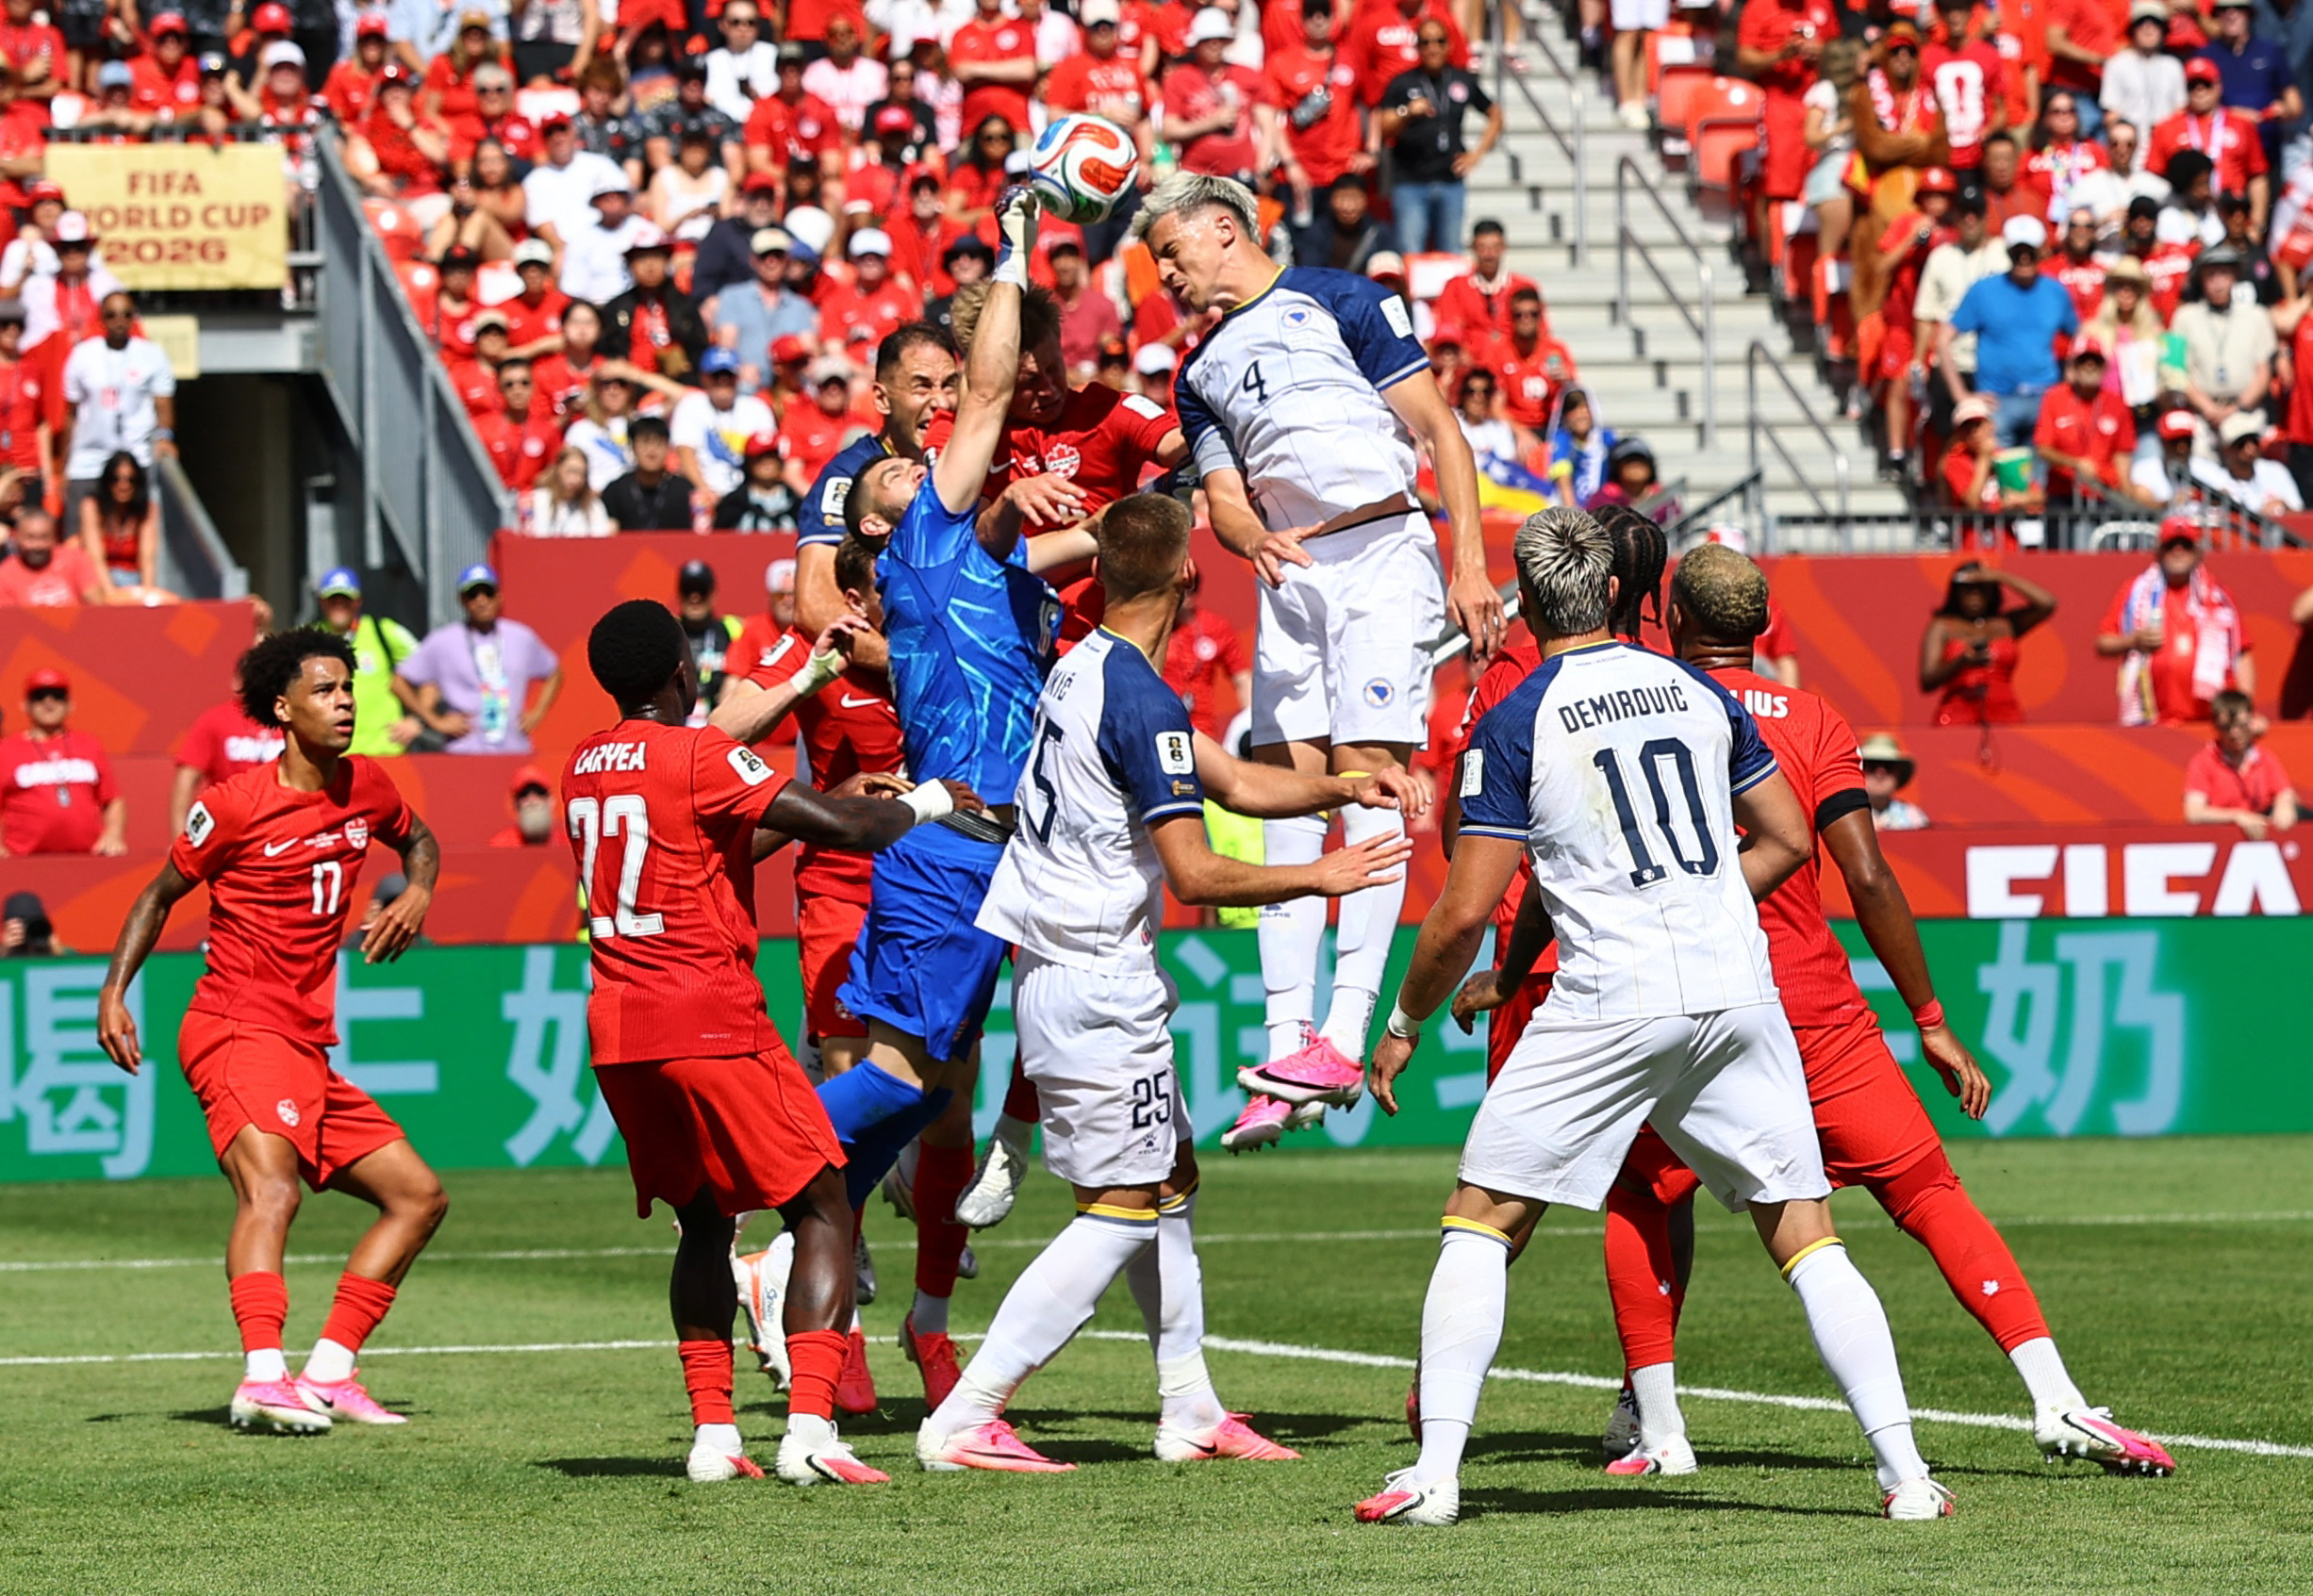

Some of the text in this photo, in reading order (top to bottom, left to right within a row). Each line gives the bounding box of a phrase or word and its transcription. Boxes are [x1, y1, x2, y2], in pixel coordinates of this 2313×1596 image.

[127, 173, 203, 195] FIFA
[85, 205, 272, 230] ORLD CUP
[105, 239, 227, 265] 2026
[1242, 359, 1268, 403] 4
[1044, 668, 1076, 701] KIĆ
[1558, 678, 1689, 734] DEMIROVIĆ
[1728, 689, 1789, 719] IUS
[573, 741, 647, 776] LARYEA
[1593, 736, 1723, 890] 10
[311, 860, 342, 915] 17
[568, 794, 666, 938] 22
[1965, 841, 2302, 919] FIFA
[1132, 1069, 1170, 1129] 25
